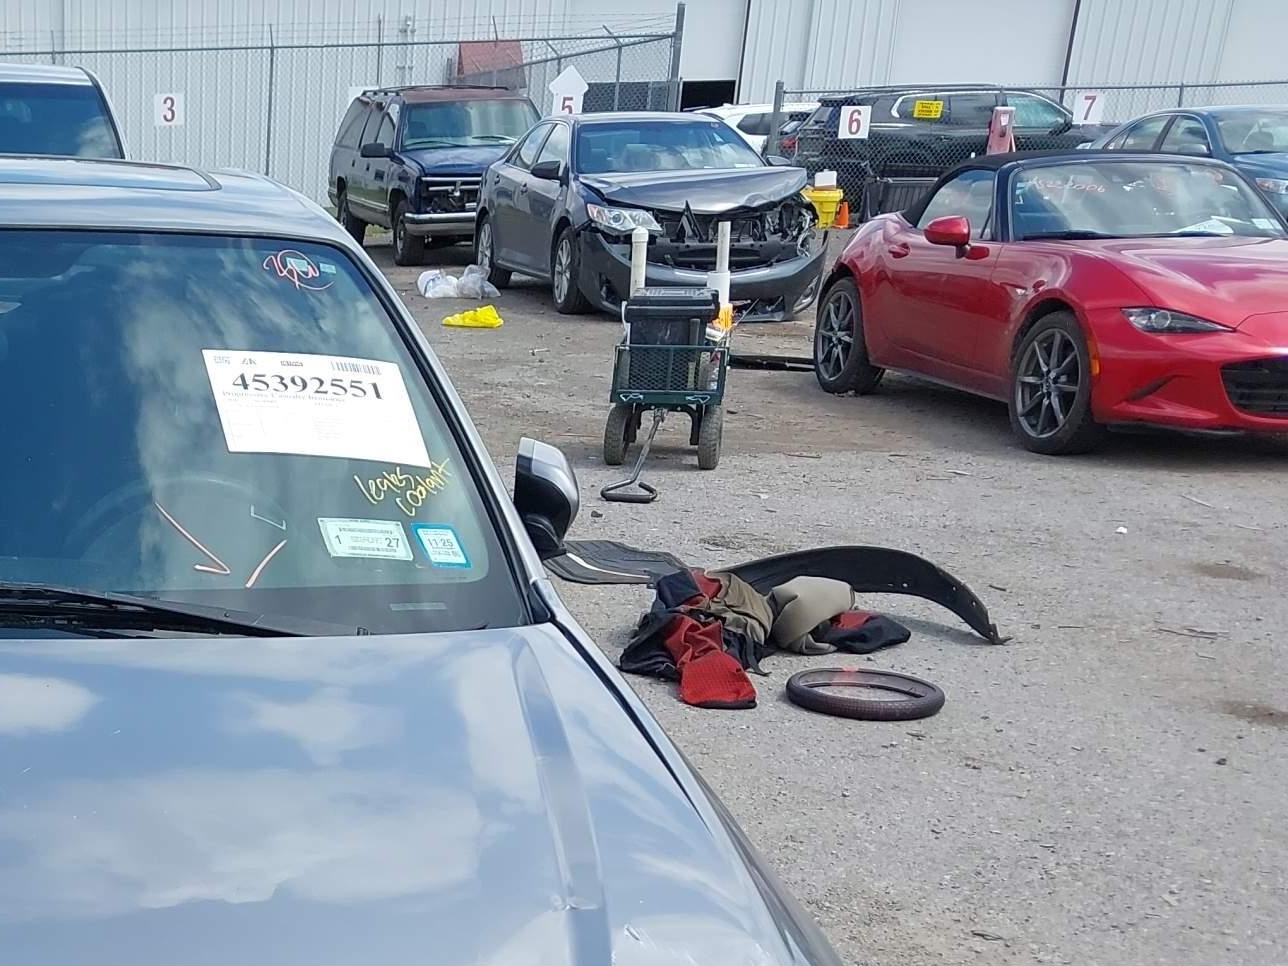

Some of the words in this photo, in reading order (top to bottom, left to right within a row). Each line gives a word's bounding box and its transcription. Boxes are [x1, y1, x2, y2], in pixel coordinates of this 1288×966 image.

[163, 96, 176, 122] 3
[561, 96, 574, 115] 5
[1083, 95, 1097, 121] 7
[847, 109, 862, 135] 6
[231, 372, 384, 400] 45392551
[384, 537, 400, 548] 27
